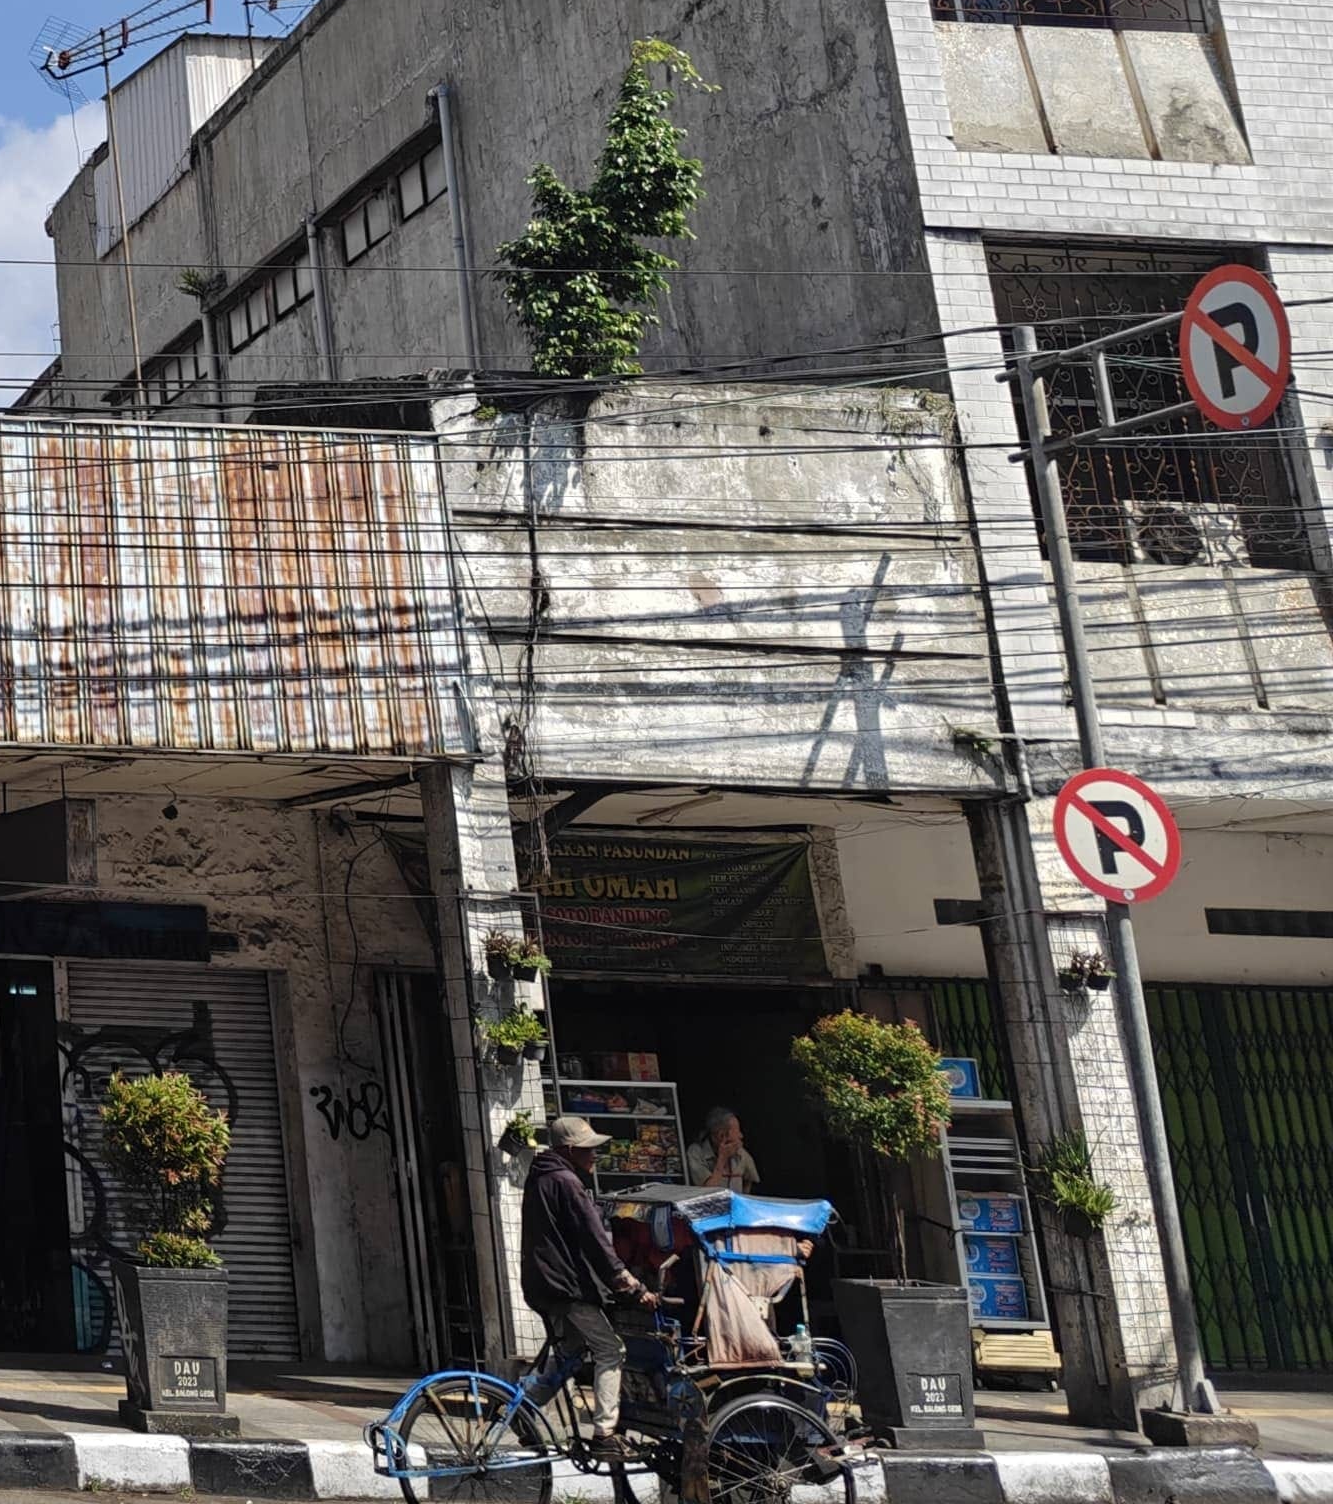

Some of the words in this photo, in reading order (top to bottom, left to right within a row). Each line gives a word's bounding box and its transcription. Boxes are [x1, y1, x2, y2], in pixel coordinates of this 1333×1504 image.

[548, 842, 598, 857] AKAN
[603, 846, 691, 861] PASUNDAN
[589, 907, 671, 927] BANDUNG
[174, 1360, 201, 1376] DAU
[177, 1376, 198, 1387] 2023
[920, 1377, 947, 1392] DAU
[924, 1392, 945, 1403] 2023
